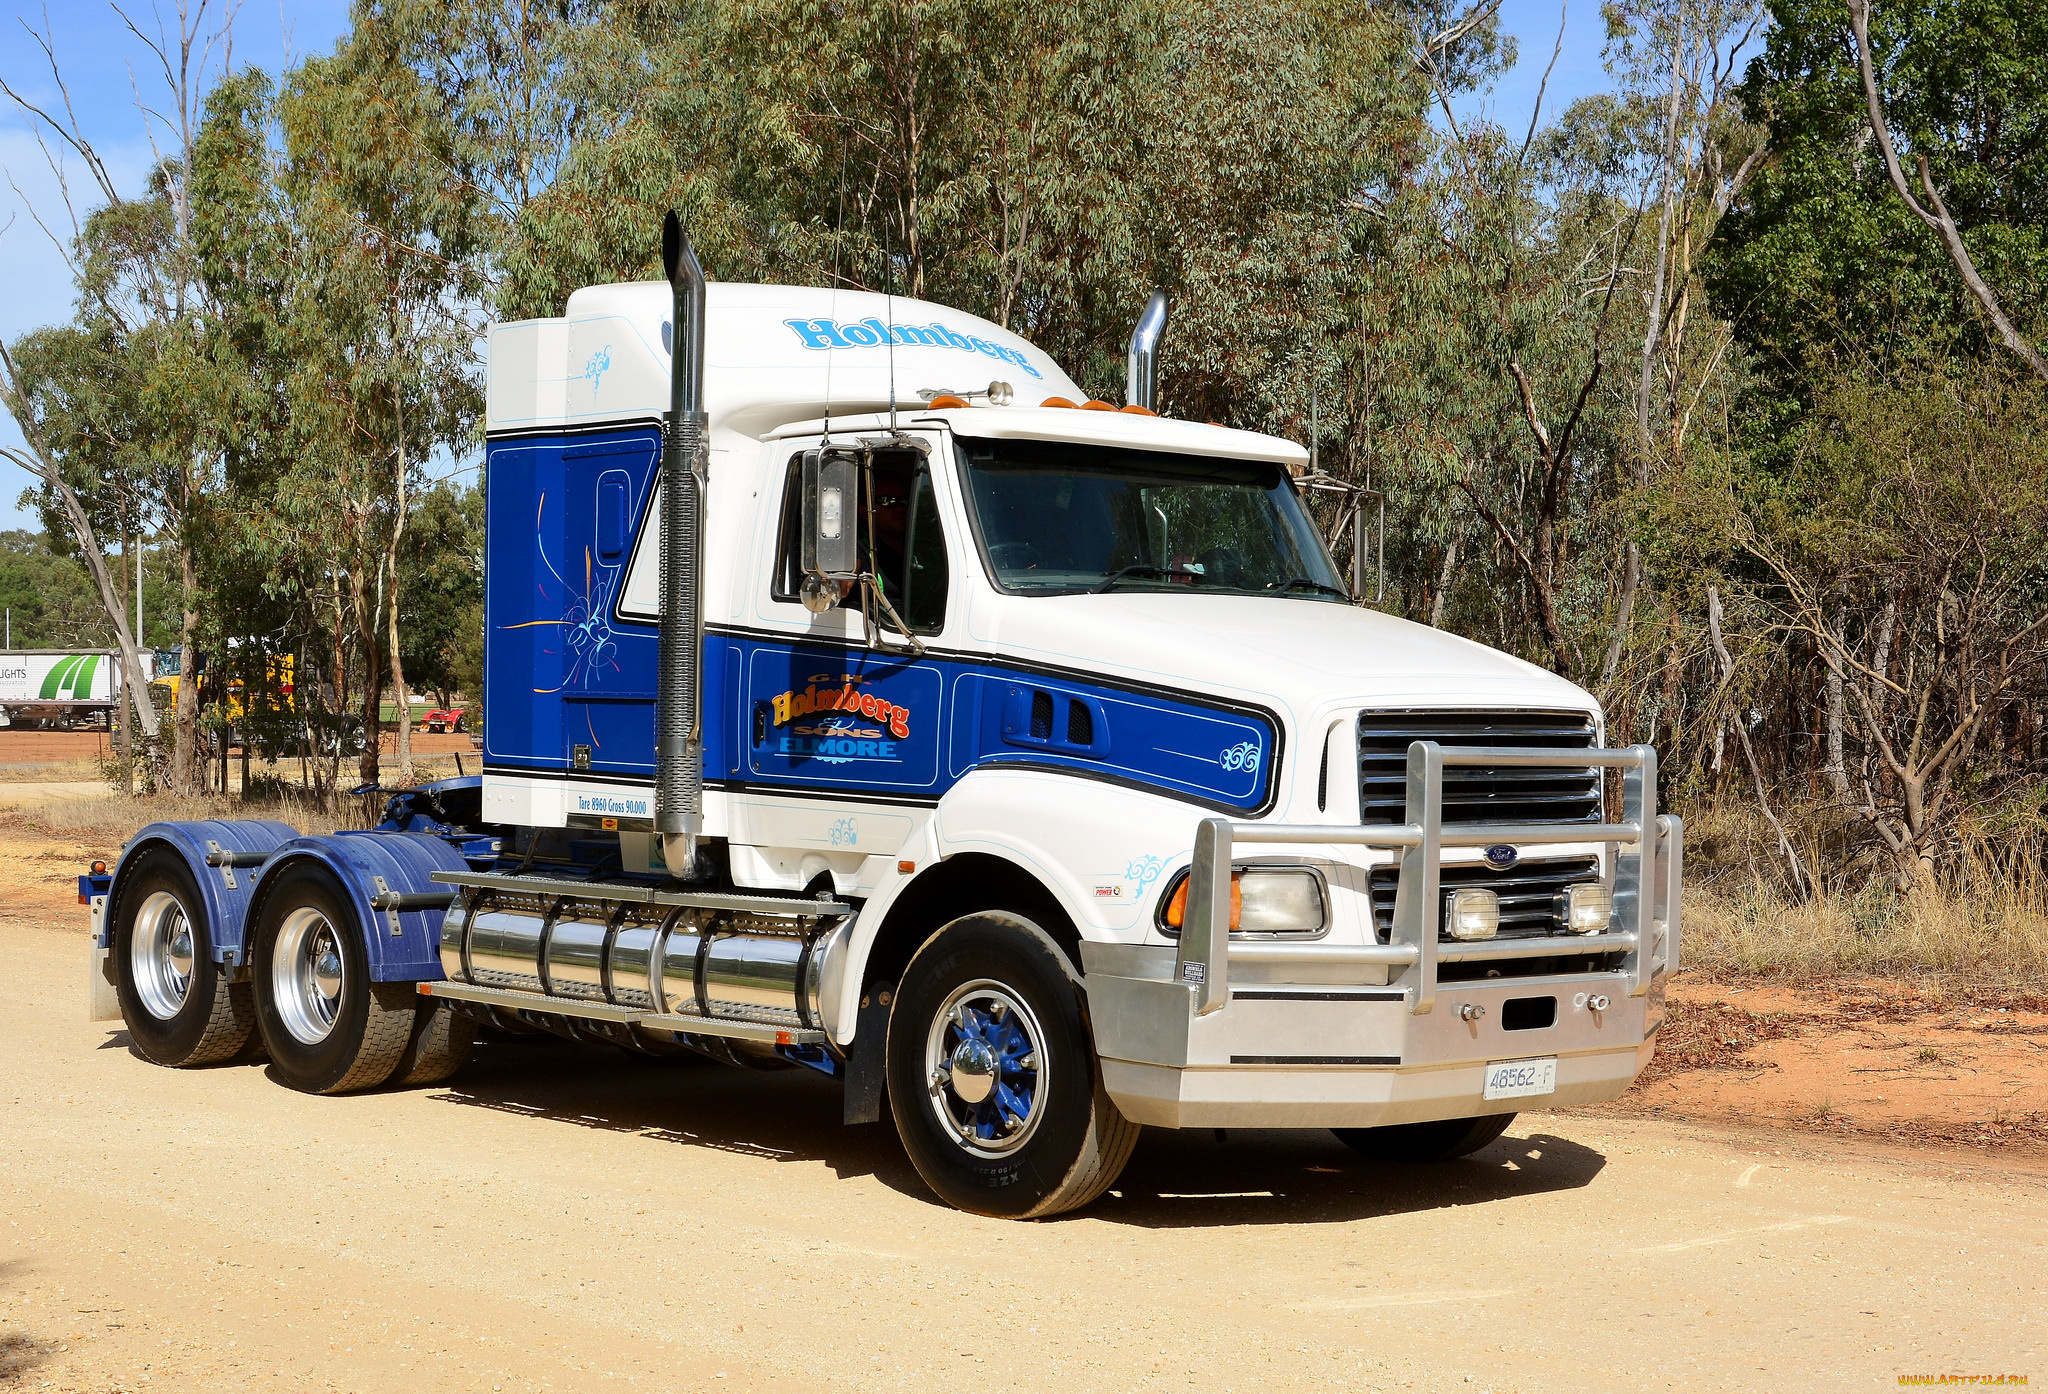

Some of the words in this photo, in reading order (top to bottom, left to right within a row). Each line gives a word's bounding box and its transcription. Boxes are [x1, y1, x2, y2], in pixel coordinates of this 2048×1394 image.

[783, 317, 1043, 380] Holmberg
[772, 683, 910, 738] Holmberg
[793, 726, 883, 738] SONS
[779, 737, 897, 758] ELMORE
[578, 796, 590, 810] Tare
[591, 797, 606, 812] 8960
[608, 800, 625, 813] Gross
[626, 800, 647, 815] 90.000
